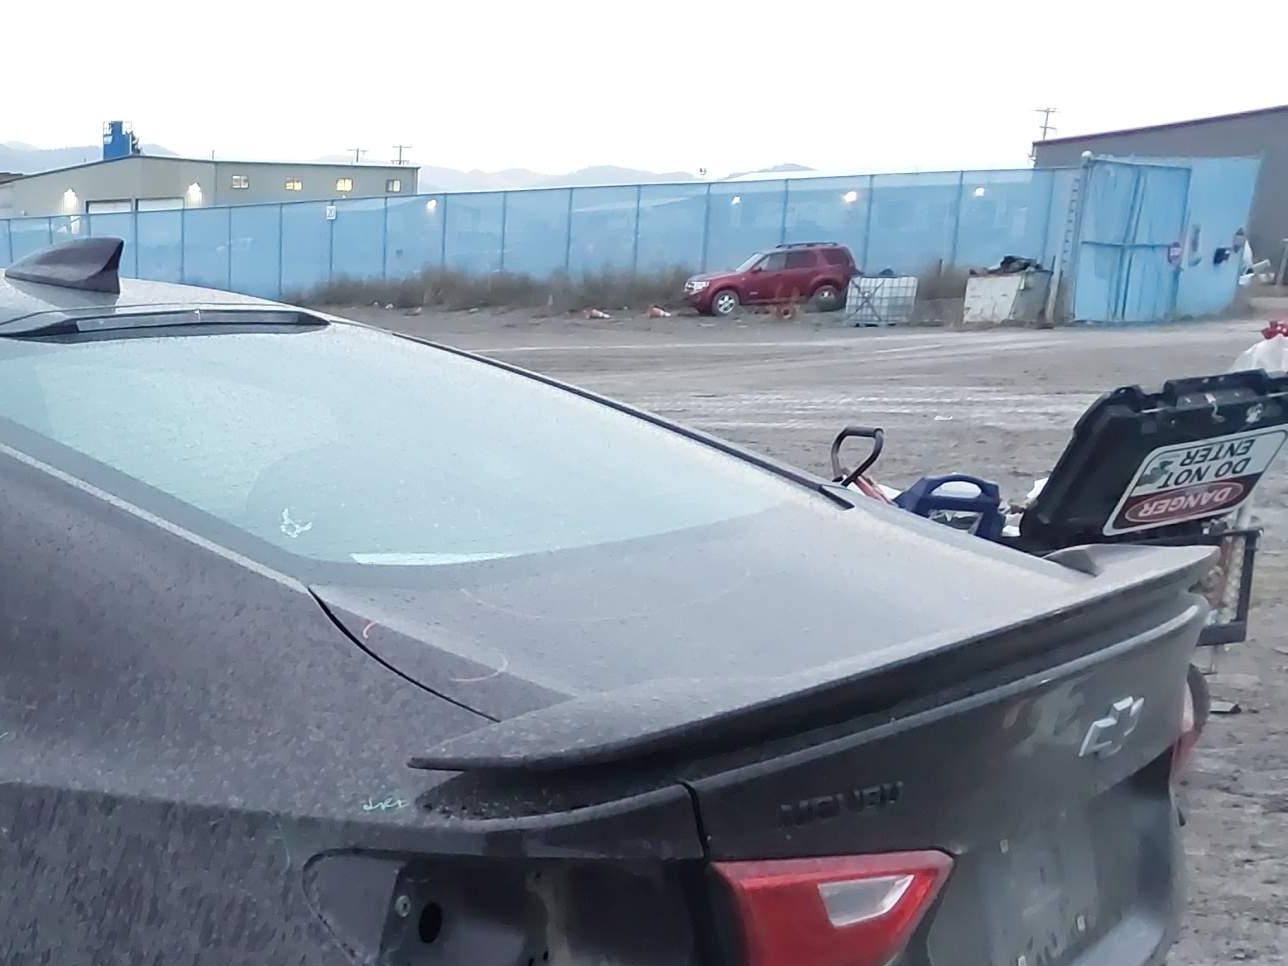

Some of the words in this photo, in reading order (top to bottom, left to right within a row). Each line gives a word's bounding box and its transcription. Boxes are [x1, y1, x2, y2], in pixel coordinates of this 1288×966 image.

[1179, 439, 1256, 467] ENTER
[1157, 465, 1211, 489] NOT
[1214, 457, 1251, 478] DO
[1138, 486, 1233, 517] DANGER
